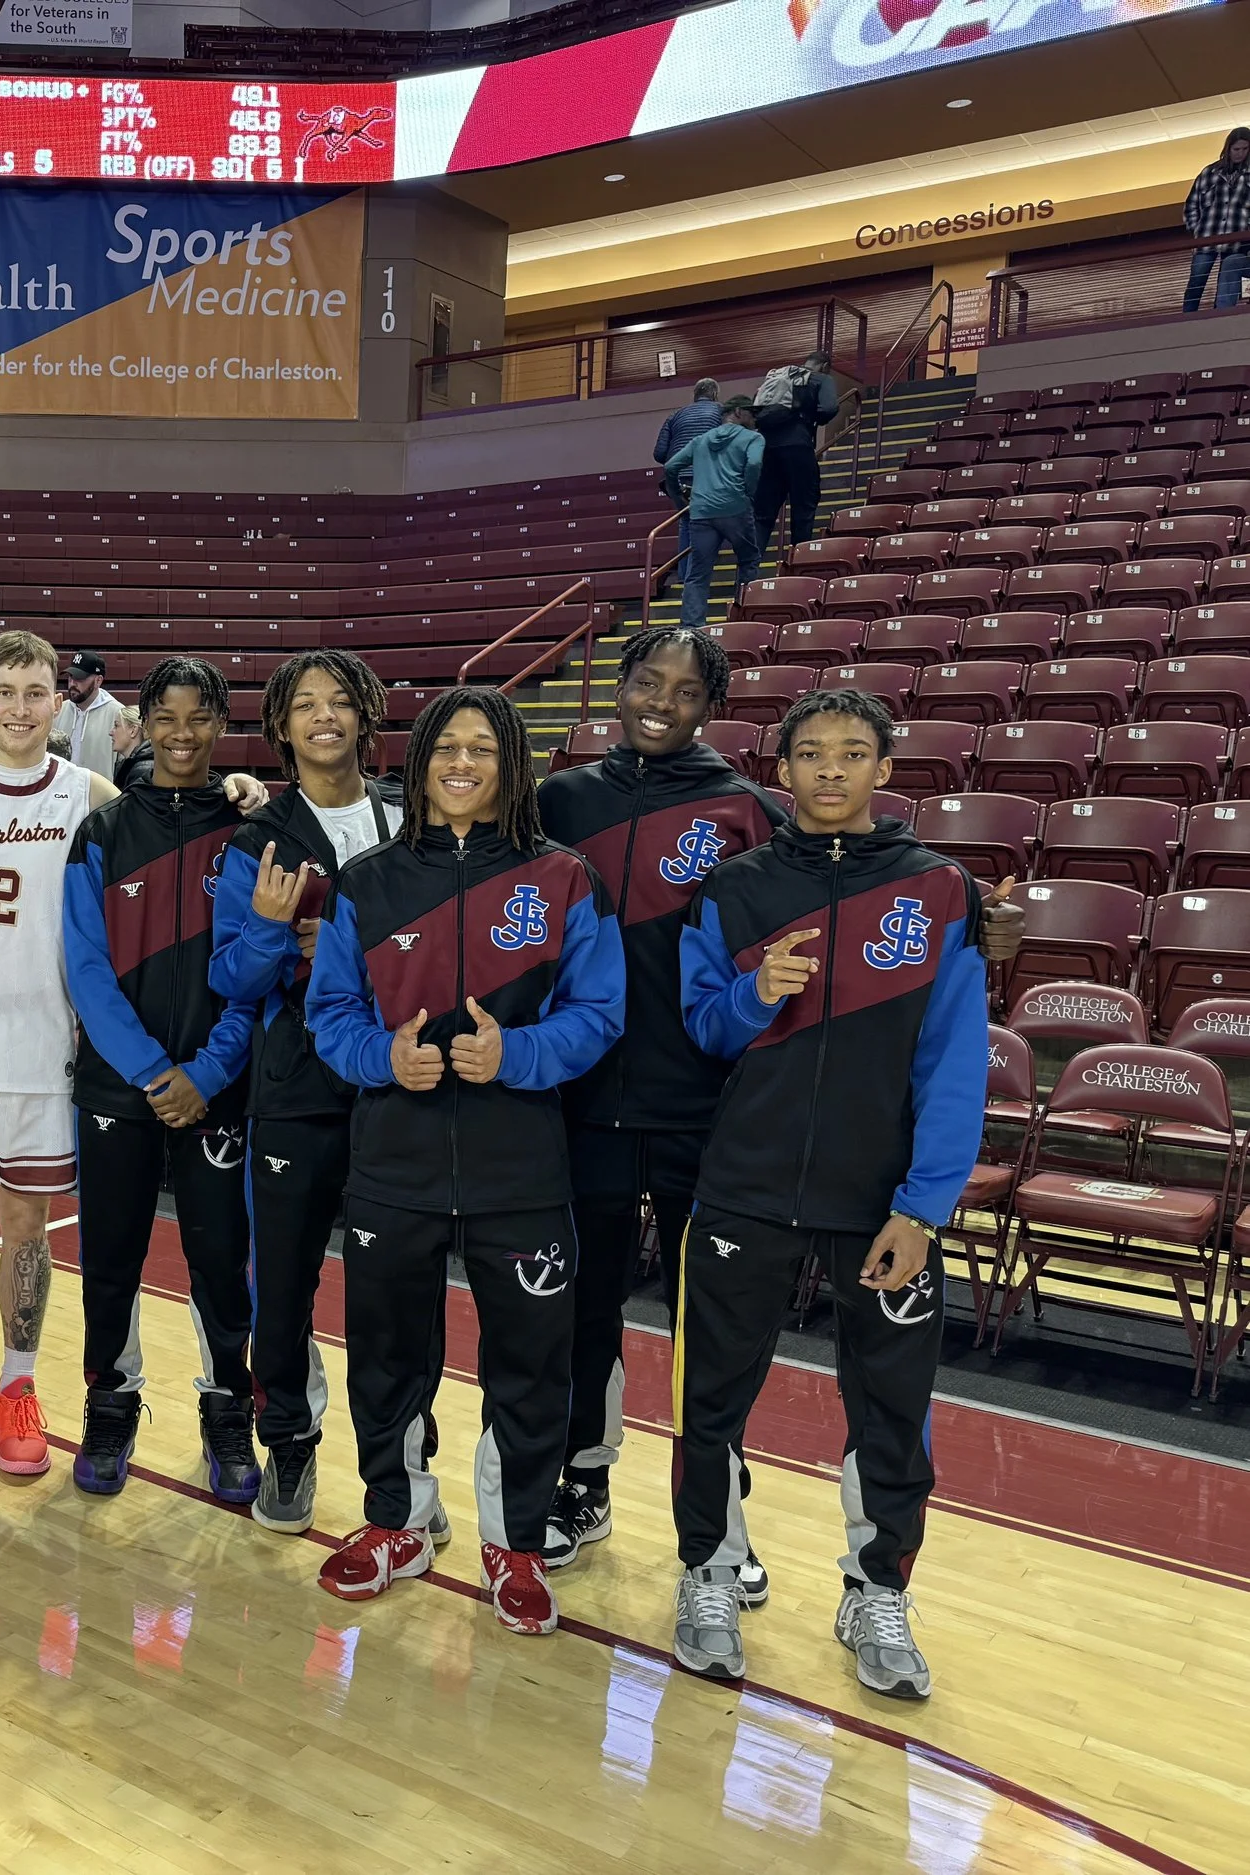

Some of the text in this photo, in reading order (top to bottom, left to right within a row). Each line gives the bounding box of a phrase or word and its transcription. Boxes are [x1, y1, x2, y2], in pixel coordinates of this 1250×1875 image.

[10, 4, 109, 20] for Veterans in
[10, 20, 76, 35] the South
[101, 82, 143, 104] FG%
[101, 107, 156, 128] 3PT%
[100, 131, 142, 152] FT%
[33, 149, 53, 174] 5
[100, 154, 136, 176] REB
[144, 156, 195, 181] (OFF)
[855, 198, 1054, 250] Concessions
[105, 203, 294, 280] Sports
[147, 267, 346, 317] Medicine
[381, 266, 395, 333] 110
[32, 354, 63, 376] for
[69, 355, 102, 378] the
[109, 355, 189, 384] College
[195, 357, 217, 379] of
[223, 357, 342, 381] Charleston.
[1024, 1001, 1133, 1024] CHARLESTON
[1038, 993, 1124, 1020] COLLEGE of
[1193, 1018, 1250, 1037] CHARL
[1082, 1069, 1201, 1096] CHARLESTON
[1097, 1061, 1190, 1088] COLLEGE of
